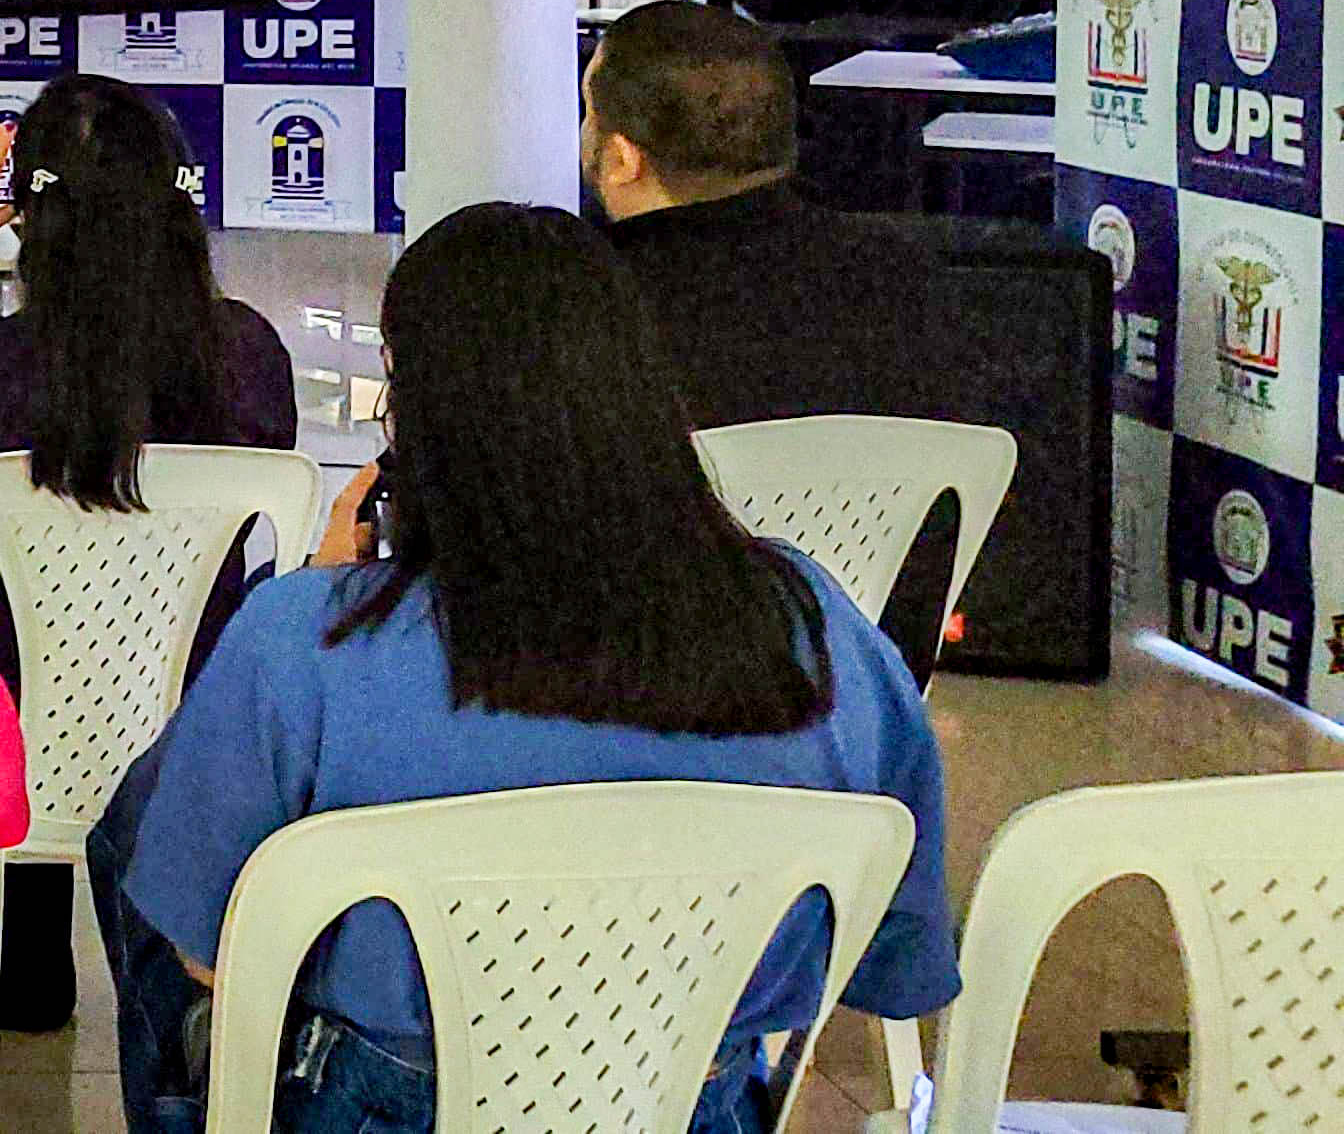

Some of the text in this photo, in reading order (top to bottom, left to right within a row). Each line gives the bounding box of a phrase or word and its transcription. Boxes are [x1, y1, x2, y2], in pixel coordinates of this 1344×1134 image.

[242, 19, 355, 59] UPE
[1193, 82, 1305, 167] UPE
[1182, 578, 1293, 687] UPE
